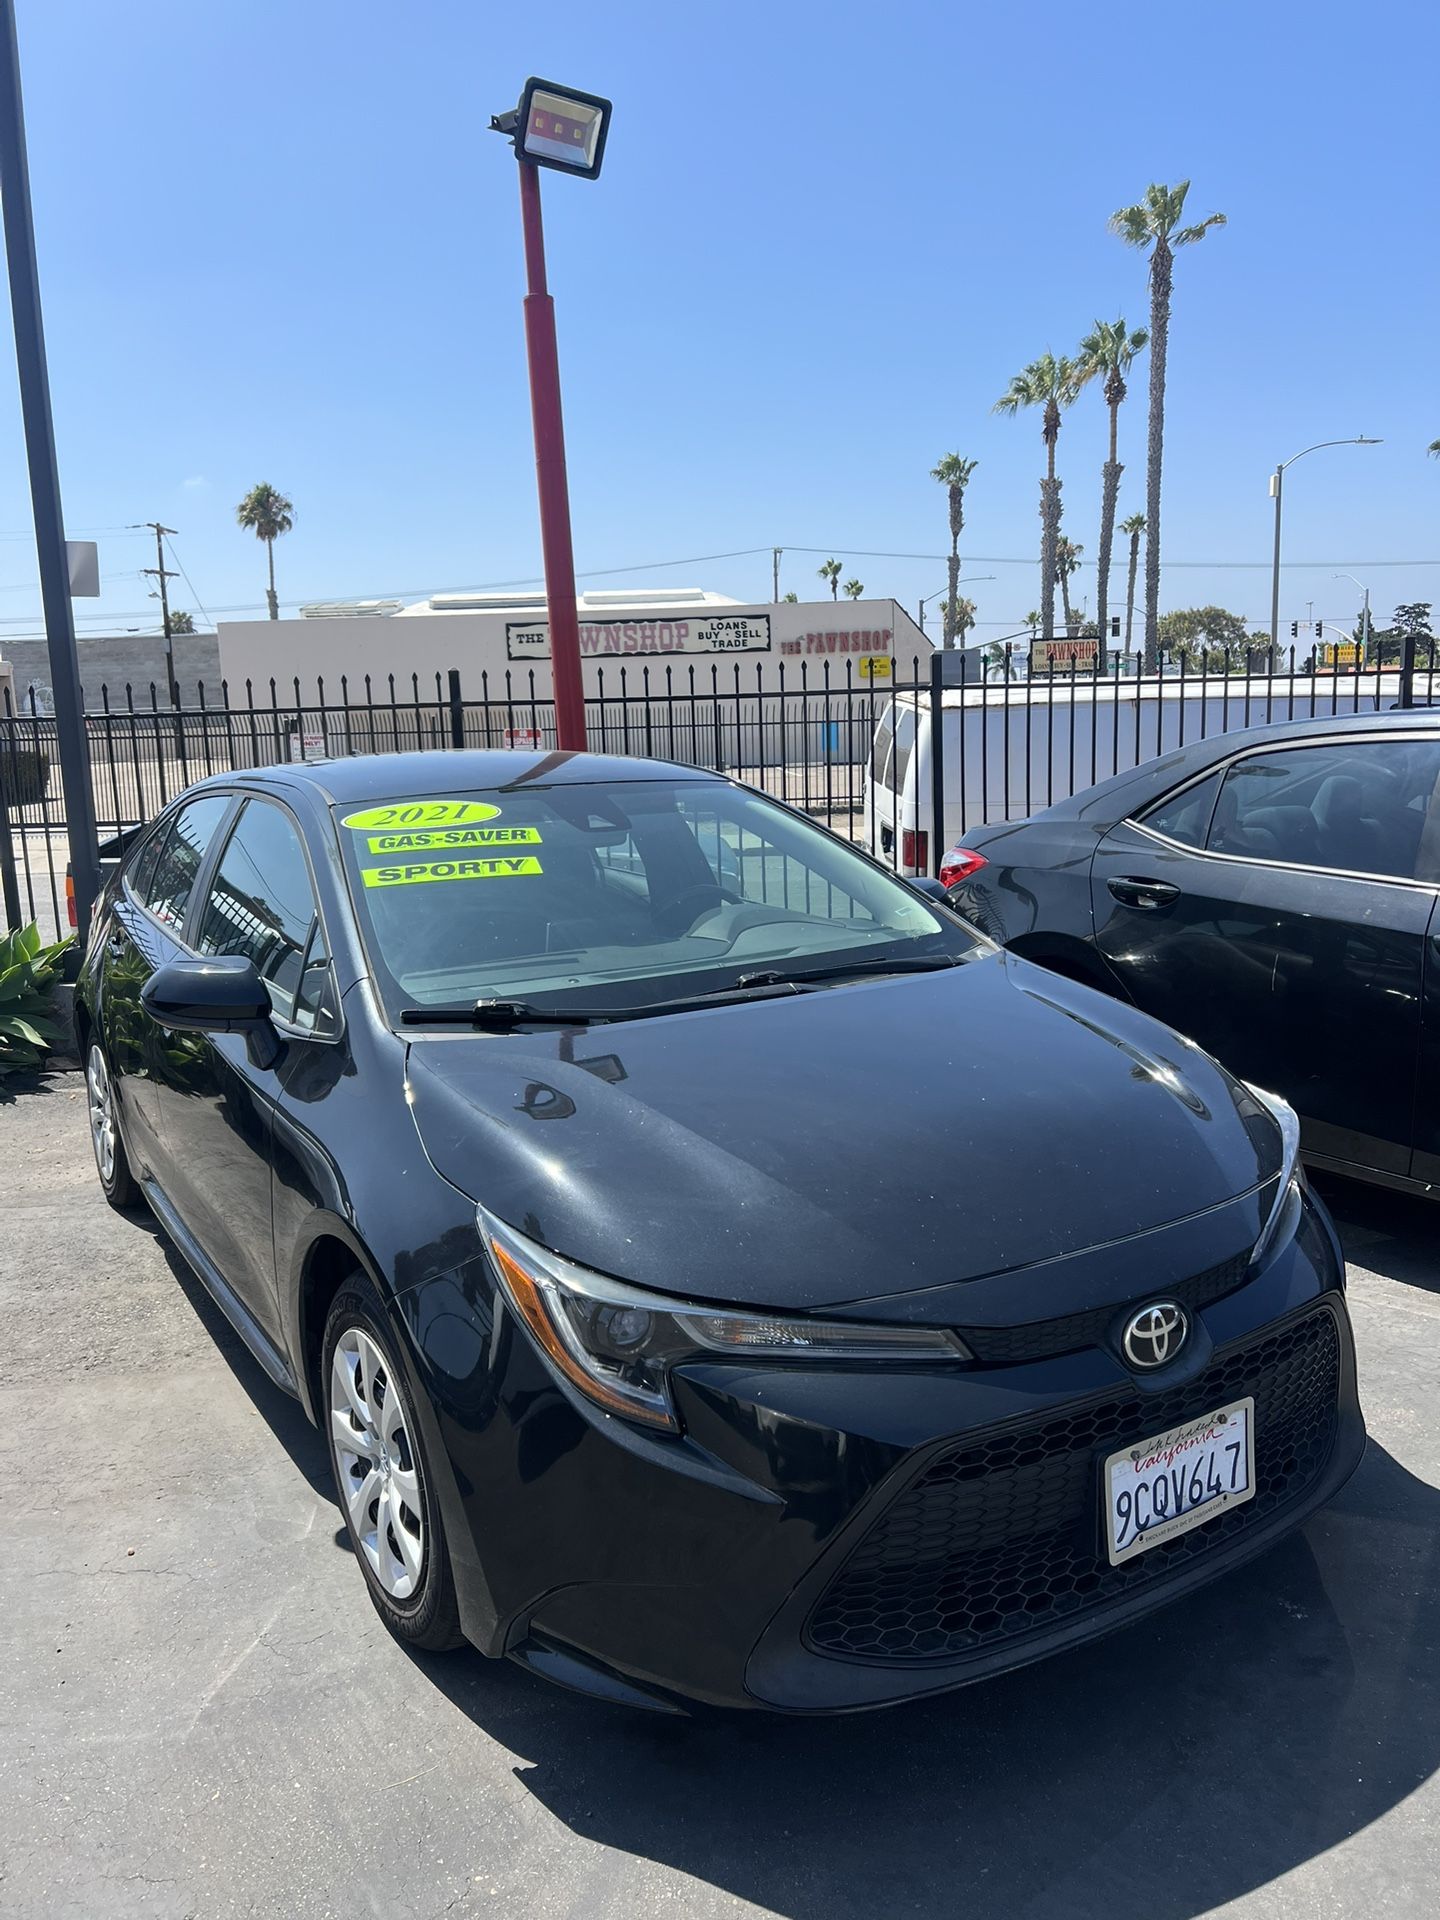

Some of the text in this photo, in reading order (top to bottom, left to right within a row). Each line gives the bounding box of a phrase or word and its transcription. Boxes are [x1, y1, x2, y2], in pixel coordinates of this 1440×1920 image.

[698, 629, 762, 641] BUY SELL
[710, 621, 748, 631] LOANS
[516, 633, 545, 644] THE
[712, 639, 748, 649] TRADE
[781, 629, 892, 655] THE PAWNSHOP
[1046, 641, 1097, 660] PAWNSHOP
[373, 804, 470, 826] 2021
[378, 829, 530, 850] GAS-SAVER
[377, 859, 525, 882] SPORTY
[1134, 1427, 1225, 1473] California
[1116, 1441, 1241, 1543] 9CQV647
